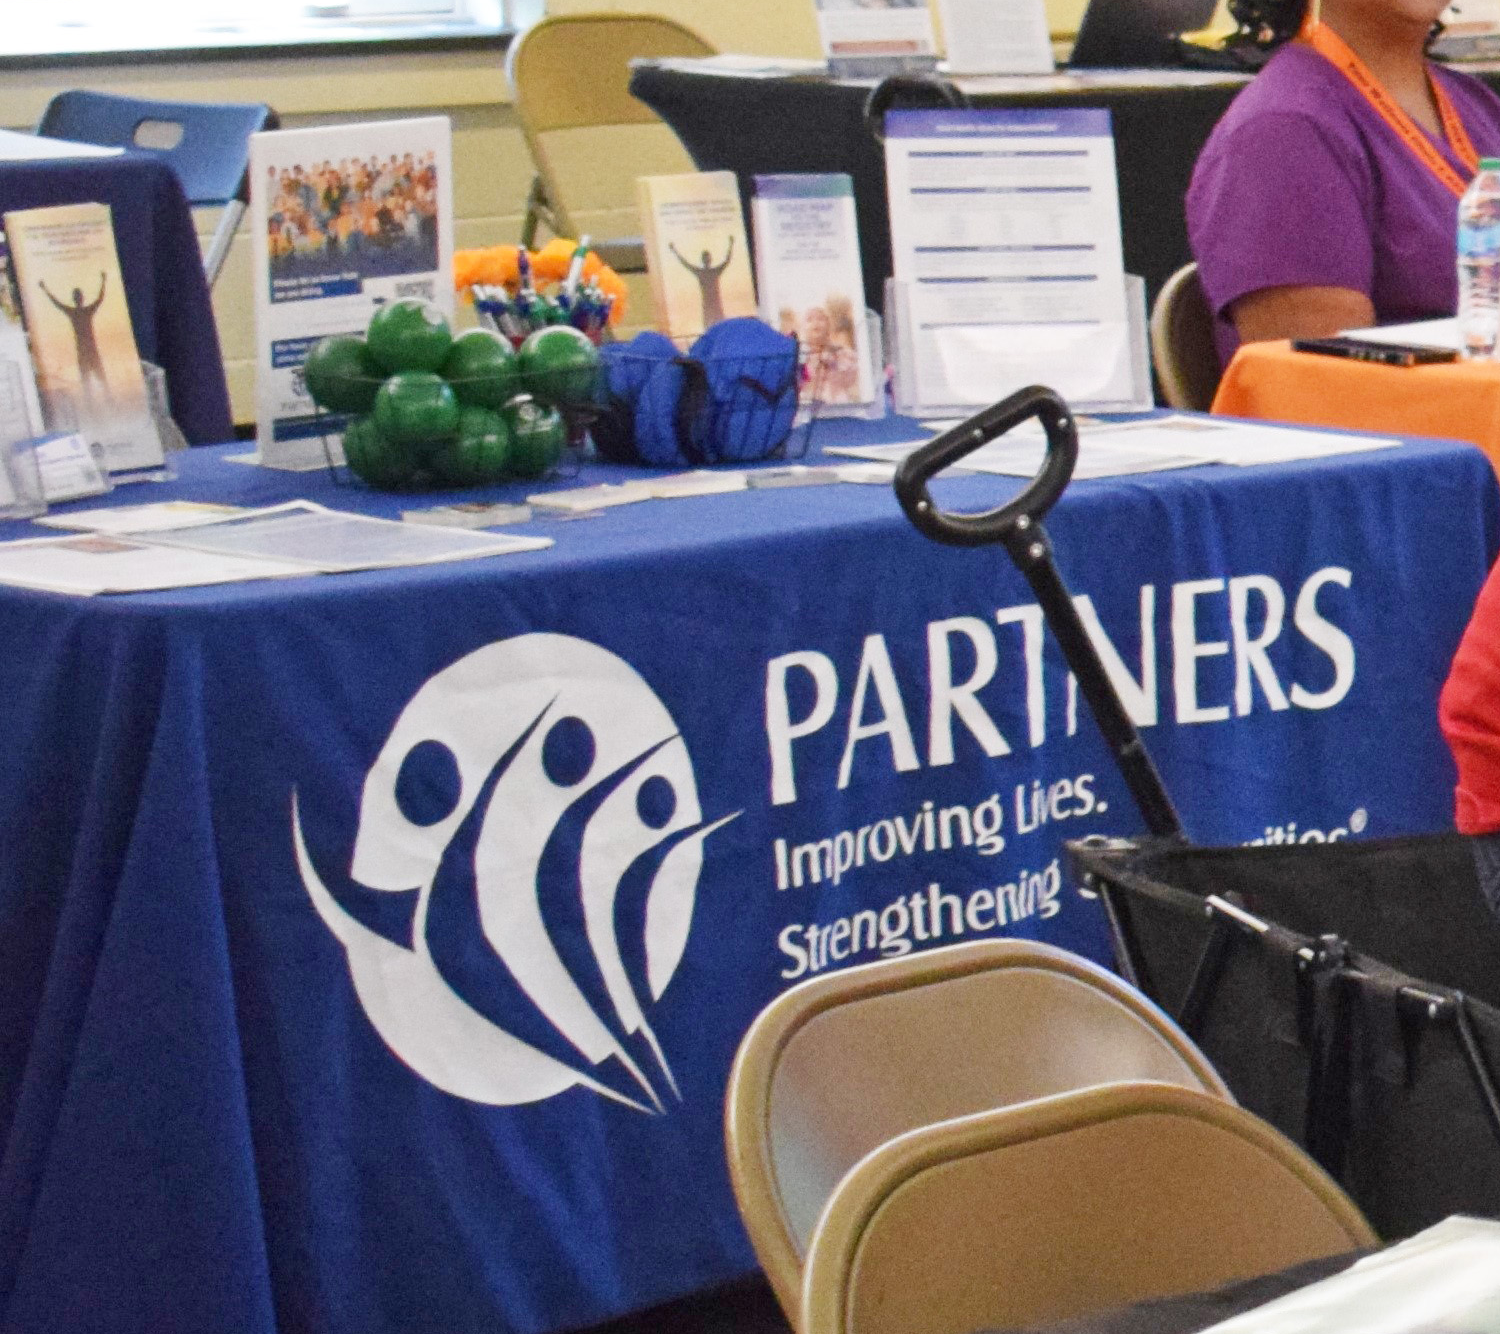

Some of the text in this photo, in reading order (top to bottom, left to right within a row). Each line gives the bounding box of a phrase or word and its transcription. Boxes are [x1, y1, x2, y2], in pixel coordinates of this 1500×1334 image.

[765, 565, 1357, 807] PARTNERS
[773, 772, 1109, 892] Improving Lives.
[779, 859, 1061, 979] Strengthening
